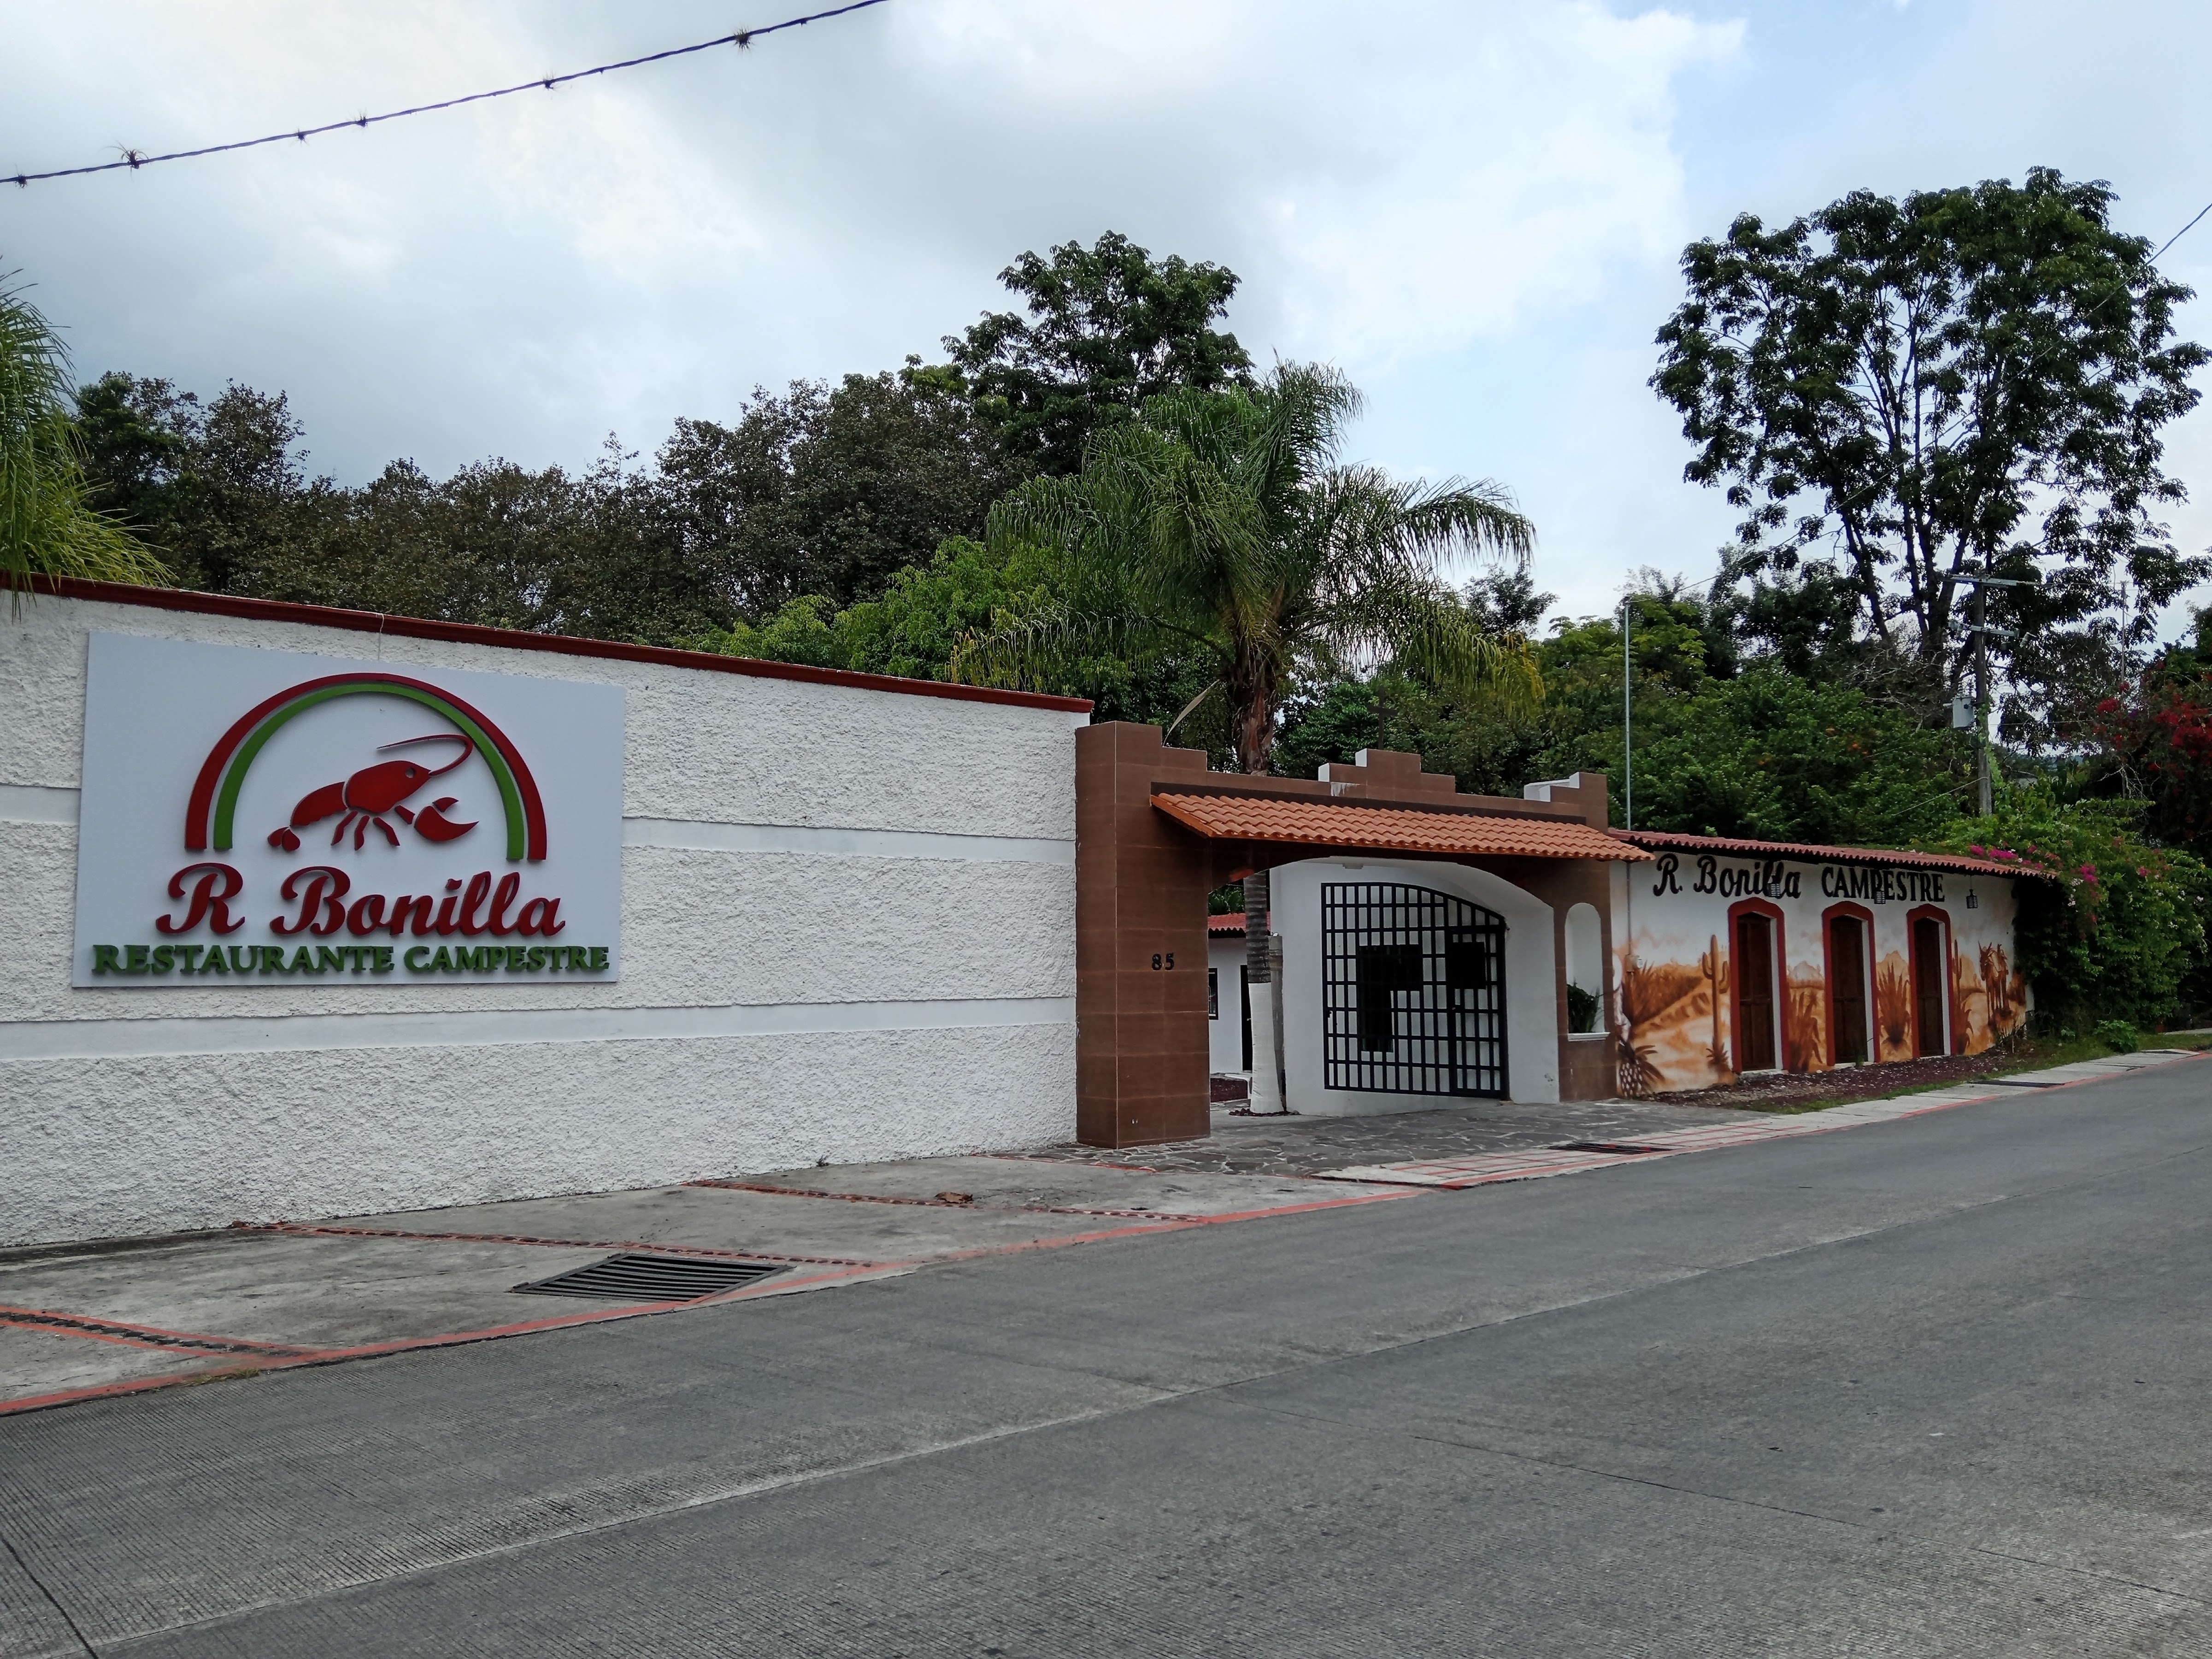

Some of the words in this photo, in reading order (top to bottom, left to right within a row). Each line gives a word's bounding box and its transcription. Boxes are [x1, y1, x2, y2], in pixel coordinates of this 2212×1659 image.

[1653, 853, 1683, 896] R.
[1694, 855, 1801, 899] Bonilla
[1821, 866, 1945, 902] CAMPESTRE
[155, 862, 245, 934] R
[270, 866, 566, 936] Bonilla
[92, 945, 395, 973] RESTAURANTE
[404, 946, 610, 971] CAMPESTRE
[1152, 953, 1174, 971] 85
